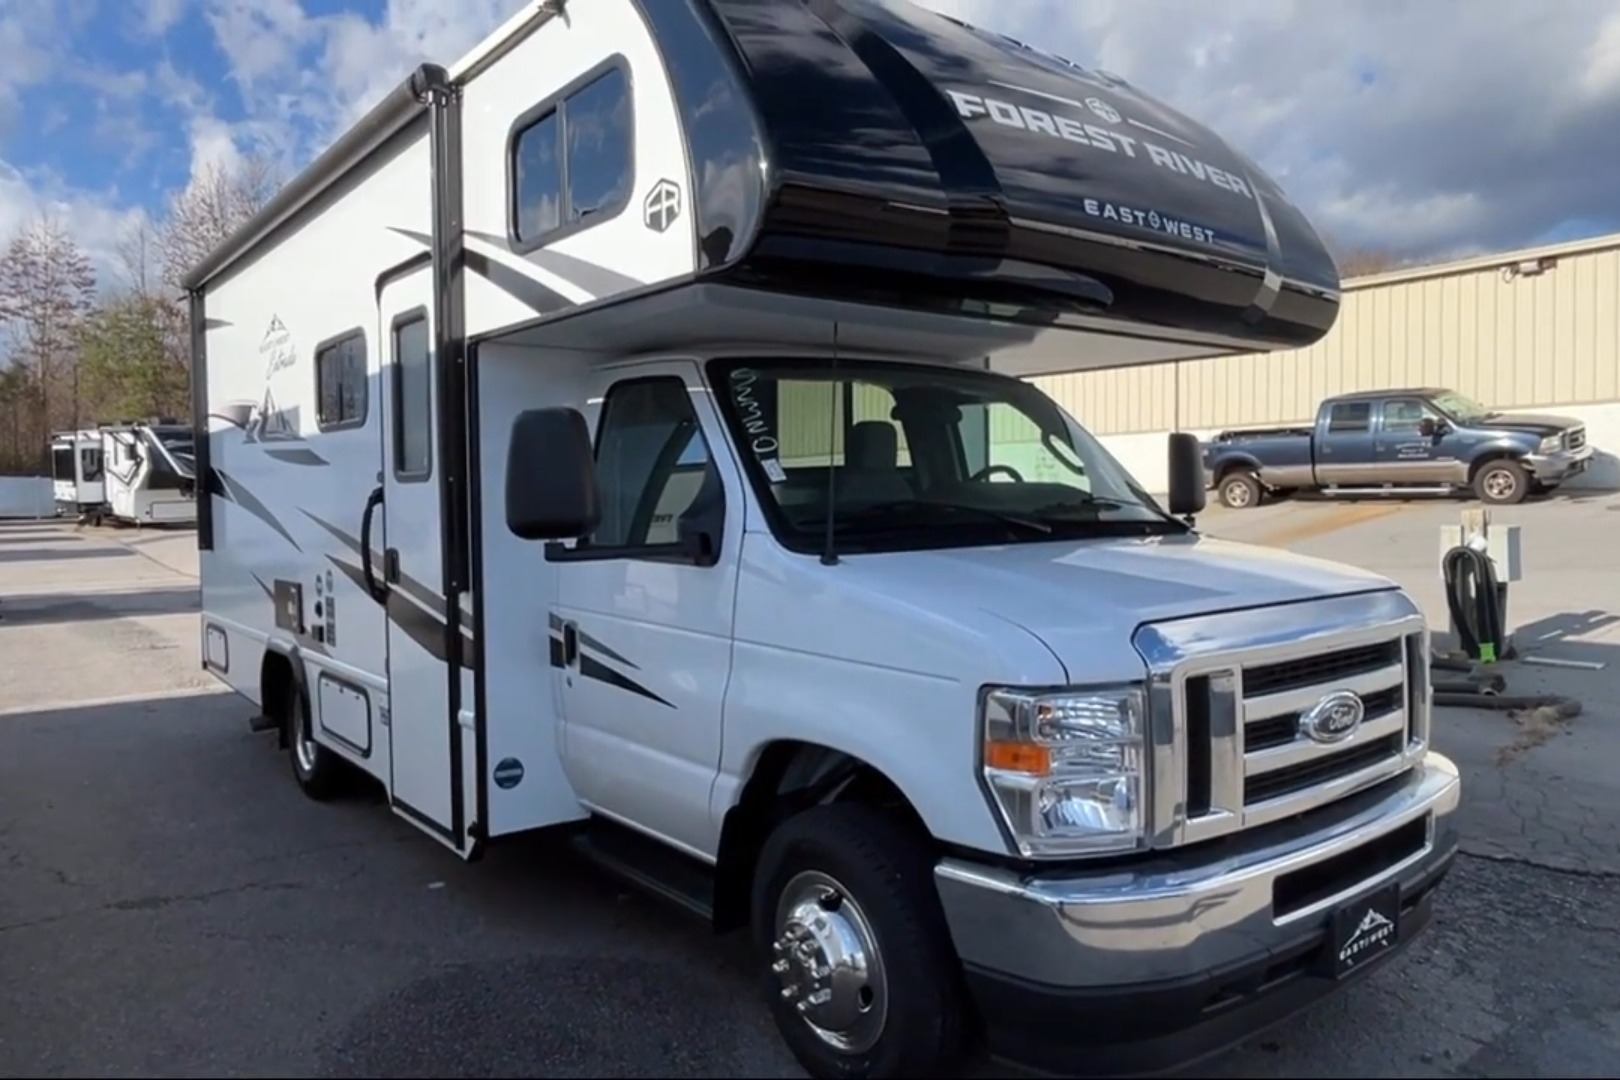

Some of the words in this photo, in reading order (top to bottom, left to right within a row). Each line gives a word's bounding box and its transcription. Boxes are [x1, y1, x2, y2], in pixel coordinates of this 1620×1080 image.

[945, 89, 1136, 158] FOREST
[1142, 142, 1253, 199] RIVER
[1083, 198, 1146, 227] EAST
[1162, 217, 1215, 244] WEST
[1329, 704, 1356, 731] Ford
